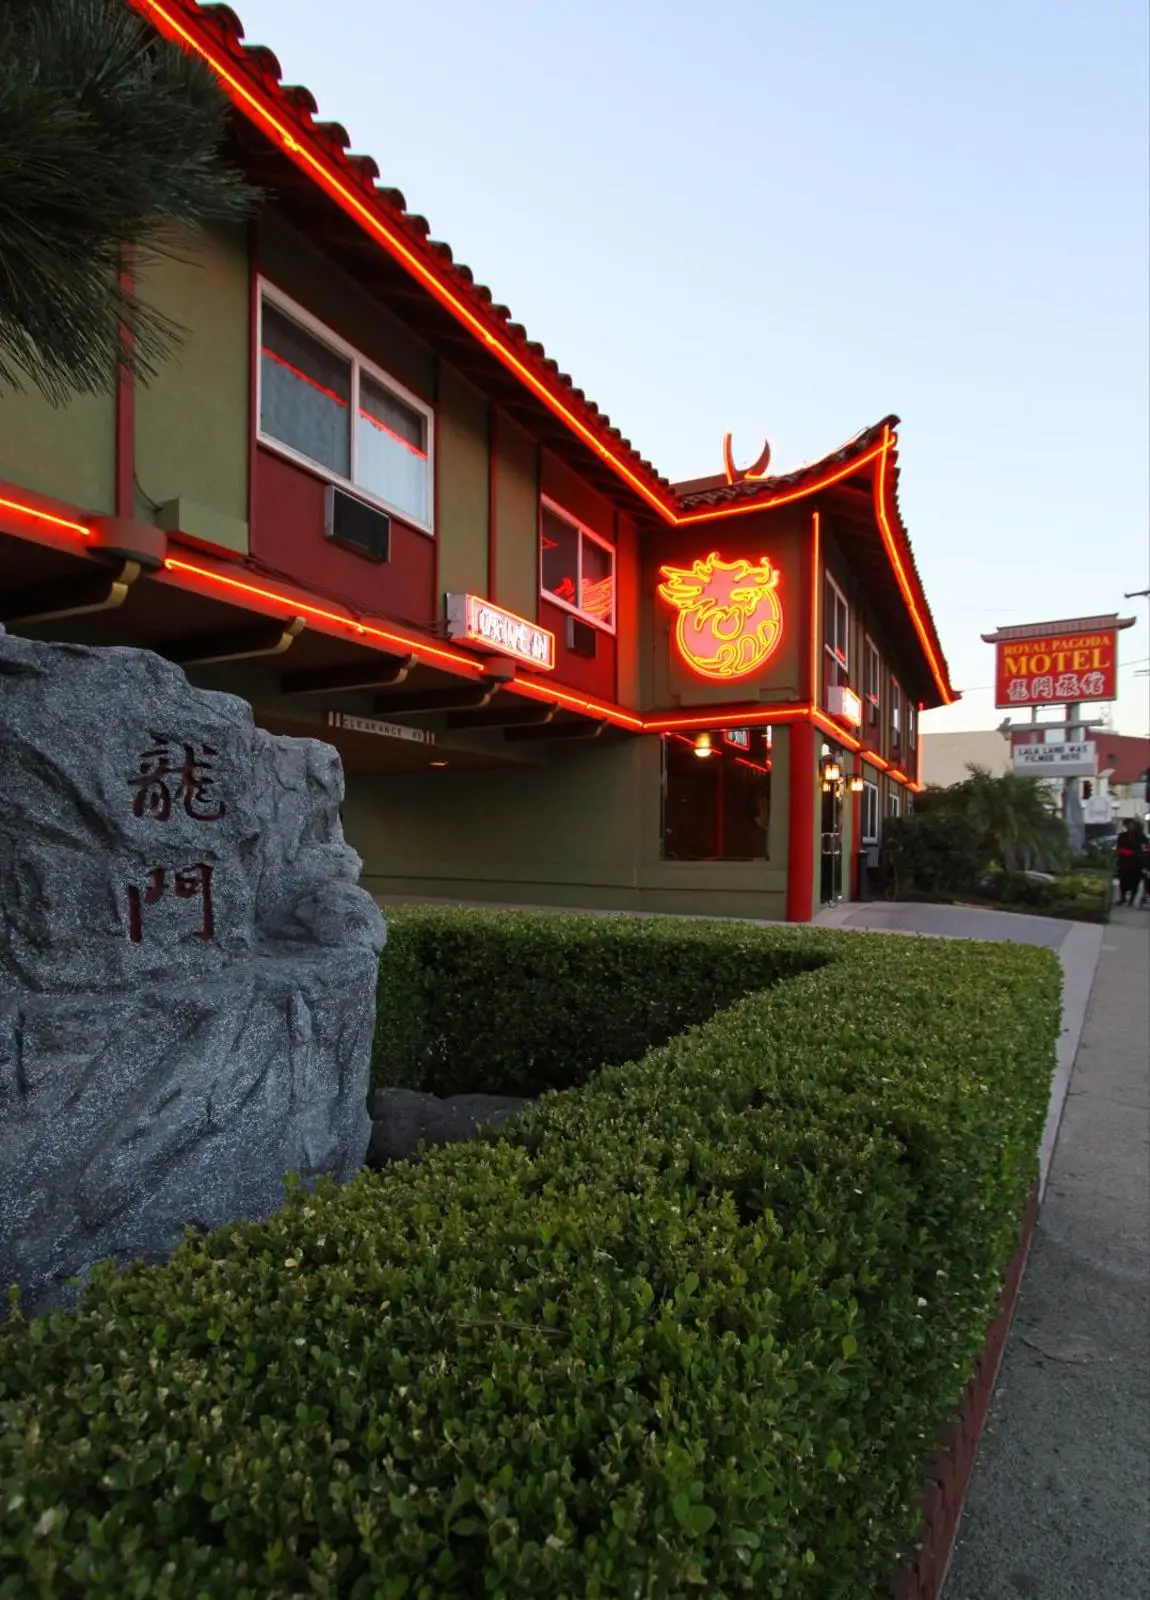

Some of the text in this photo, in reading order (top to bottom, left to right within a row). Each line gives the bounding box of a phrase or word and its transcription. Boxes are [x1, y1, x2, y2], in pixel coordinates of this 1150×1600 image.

[1003, 635, 1110, 656] ROYAL PAGODA
[1004, 649, 1110, 676] MOTEL
[343, 717, 402, 736] CLEARANCE
[1025, 753, 1080, 762] FILMED HERE
[1042, 745, 1065, 754] LAND
[127, 731, 226, 943] 龍門
